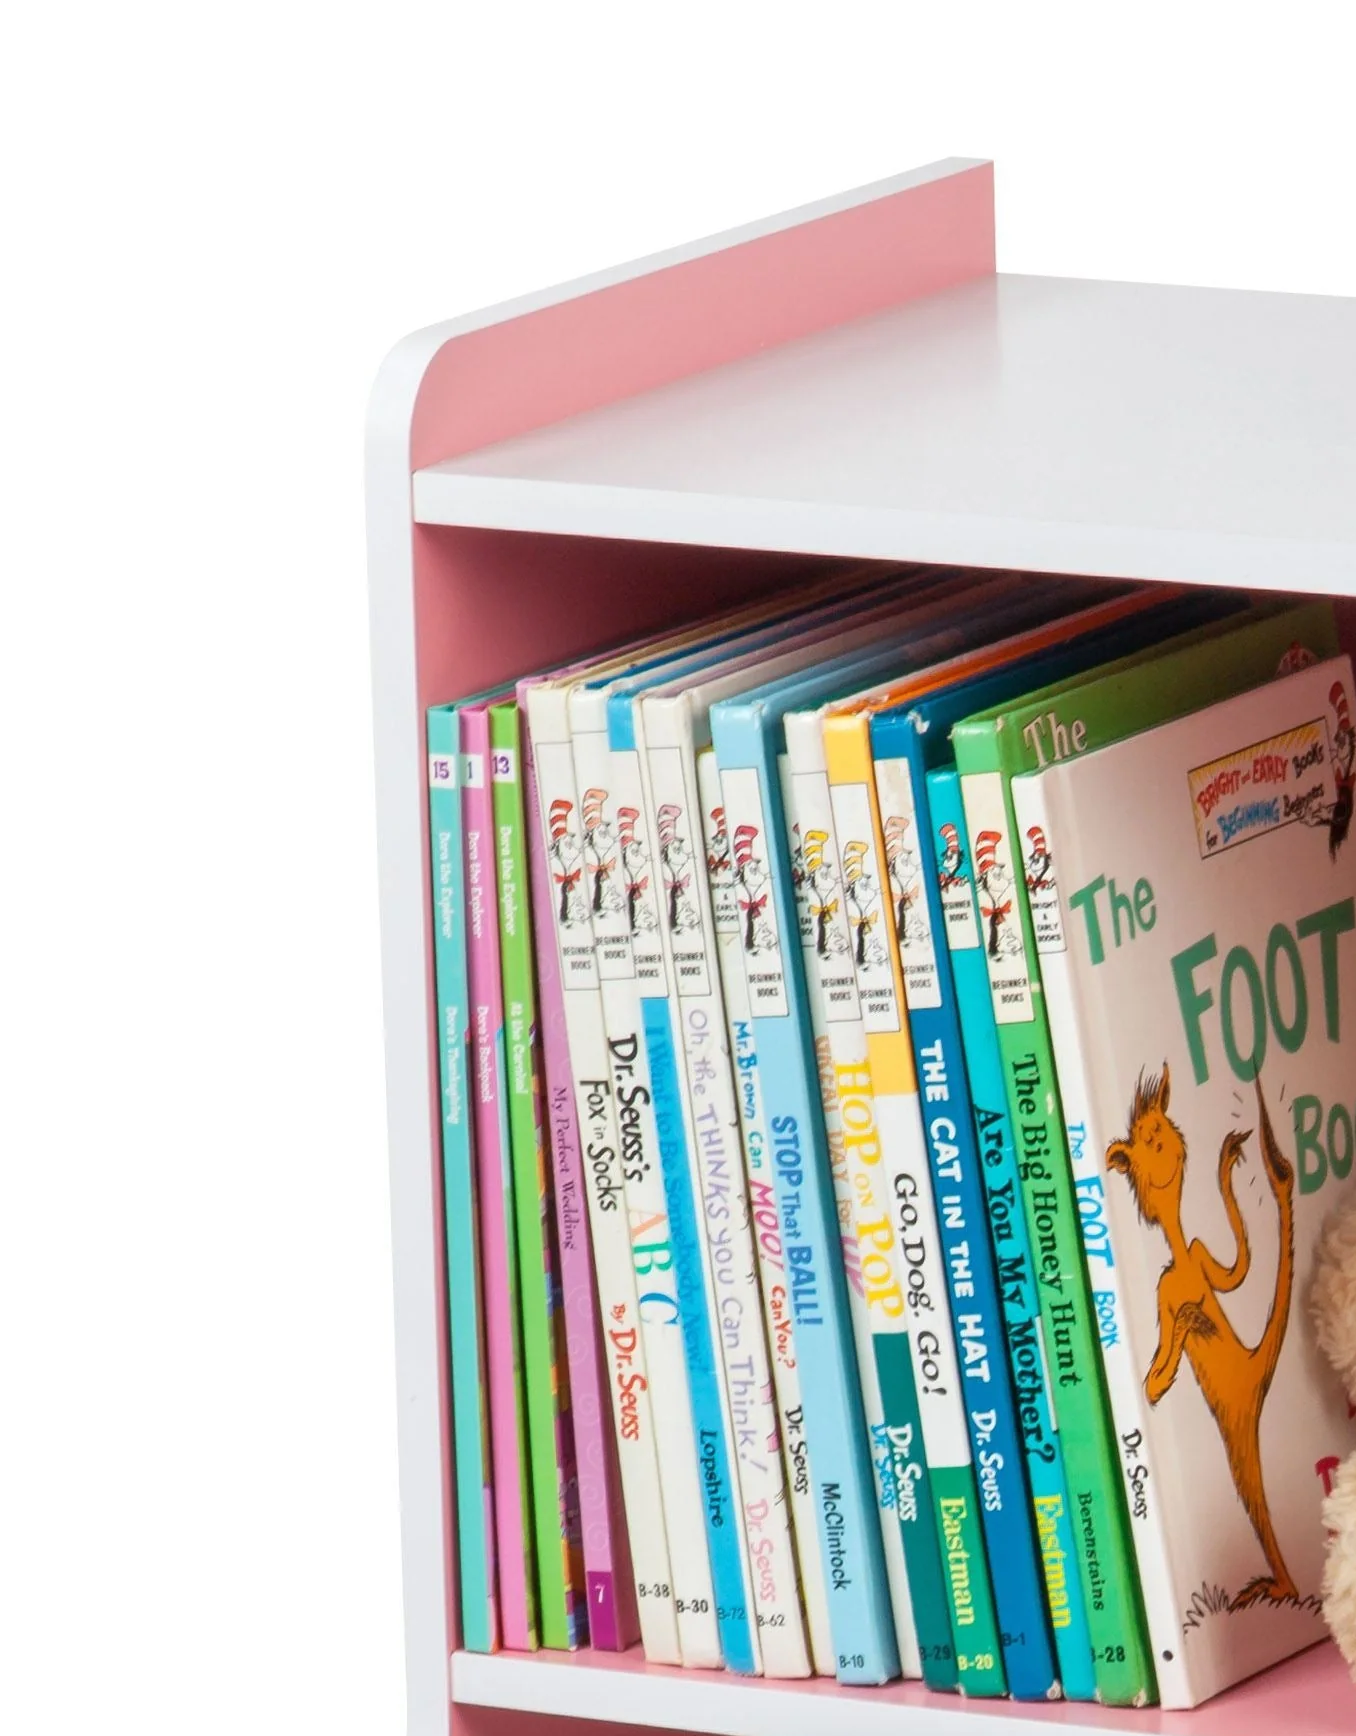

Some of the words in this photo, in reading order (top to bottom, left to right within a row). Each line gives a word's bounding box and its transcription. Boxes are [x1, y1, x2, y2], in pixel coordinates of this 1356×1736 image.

[492, 755, 510, 774] 13
[1023, 711, 1089, 768] The
[433, 761, 450, 780] 15
[467, 762, 473, 779] 1
[1196, 769, 1241, 817] BRIGHT
[1252, 754, 1288, 785] EARLY
[439, 831, 450, 859] Dora
[468, 832, 480, 860] Dora
[500, 825, 512, 855] Dora
[440, 864, 451, 884] the
[469, 865, 481, 884] the
[502, 859, 514, 880] the
[440, 887, 455, 938] Explorer
[469, 887, 485, 939] Explorer
[503, 884, 517, 936] Explorer
[1069, 872, 1157, 966] The
[571, 960, 591, 970] BOOKS
[595, 935, 629, 945] BEGINNER
[604, 950, 626, 959] BOOKS
[680, 967, 701, 976] BOOKS
[749, 973, 782, 983] BEGINNER
[757, 988, 778, 997] BOOKS
[821, 977, 854, 987] BEGINNER
[830, 991, 851, 1001] BOOKS
[910, 979, 931, 989] BOOKS
[992, 979, 1027, 990] BEGINNER
[1170, 896, 1355, 1086] FOOT
[868, 1003, 889, 1013] BOOKS
[1001, 993, 1024, 1004] BOOKS
[645, 1026, 665, 1035] I
[686, 1009, 710, 1054] Oh,
[480, 1047, 494, 1104] Backpack
[514, 1044, 529, 1095] Carnival
[608, 1033, 638, 1081] Dr.
[693, 1057, 716, 1096] the
[921, 1039, 949, 1103] THE
[553, 1087, 568, 1113] My
[580, 1080, 610, 1121] Fox
[1012, 1053, 1041, 1115] The
[593, 1126, 607, 1140] in
[616, 1086, 650, 1184] Seuss's
[657, 1113, 671, 1135] to
[834, 1060, 881, 1165] HOP
[974, 1103, 1005, 1168] Are
[556, 1118, 573, 1173] Perfect
[659, 1141, 678, 1171] Be
[696, 1103, 731, 1220] THINKS
[748, 1131, 763, 1169] Can
[771, 1115, 803, 1187] STOP
[930, 1116, 963, 1186] CAT
[1019, 1121, 1051, 1181] Big
[1068, 1120, 1086, 1159] The
[587, 1143, 622, 1212] Socks
[854, 1173, 875, 1208] ON
[562, 1181, 579, 1250] Wedding
[750, 1178, 785, 1272] MOO!
[781, 1191, 801, 1240] That
[942, 1195, 965, 1230] IN
[988, 1178, 1015, 1242] You
[1075, 1175, 1115, 1268] FOOT
[665, 1178, 699, 1301] Somebody
[709, 1228, 735, 1286] you
[1032, 1187, 1063, 1296] Honey
[787, 1245, 823, 1325] BALL!
[857, 1214, 904, 1318] POP
[949, 1240, 974, 1299] THE
[999, 1253, 1027, 1310] My
[609, 1303, 626, 1325] By
[721, 1296, 744, 1350] Can
[918, 1329, 947, 1396] Go!
[958, 1313, 991, 1383] HAT
[1048, 1299, 1082, 1389] Hunt
[616, 1374, 647, 1441] Seuss
[729, 1355, 768, 1474] Think!
[1007, 1318, 1056, 1465] Mother?
[785, 1404, 802, 1435] Dr.
[885, 1423, 912, 1461] Dr.
[971, 1409, 997, 1446] Dr.
[1122, 1428, 1143, 1459] Dr.
[700, 1430, 724, 1529] Lopshire
[789, 1440, 808, 1496] Seuss
[896, 1462, 921, 1522] Seuss
[978, 1450, 1004, 1512] Seuss
[1127, 1464, 1149, 1521] Seuss
[746, 1499, 768, 1534] Dr.
[821, 1483, 851, 1591] McClintock
[751, 1539, 776, 1602] Seuss
[940, 1496, 975, 1626] Eastman
[1034, 1494, 1071, 1628] Eastman
[1077, 1491, 1106, 1611] Berenstains
[595, 1583, 605, 1604] 7
[639, 1583, 670, 1598] B-38
[676, 1600, 709, 1613] B-30
[718, 1607, 746, 1620] B-72
[839, 1654, 865, 1669] B-10
[957, 1653, 994, 1671] B-20
